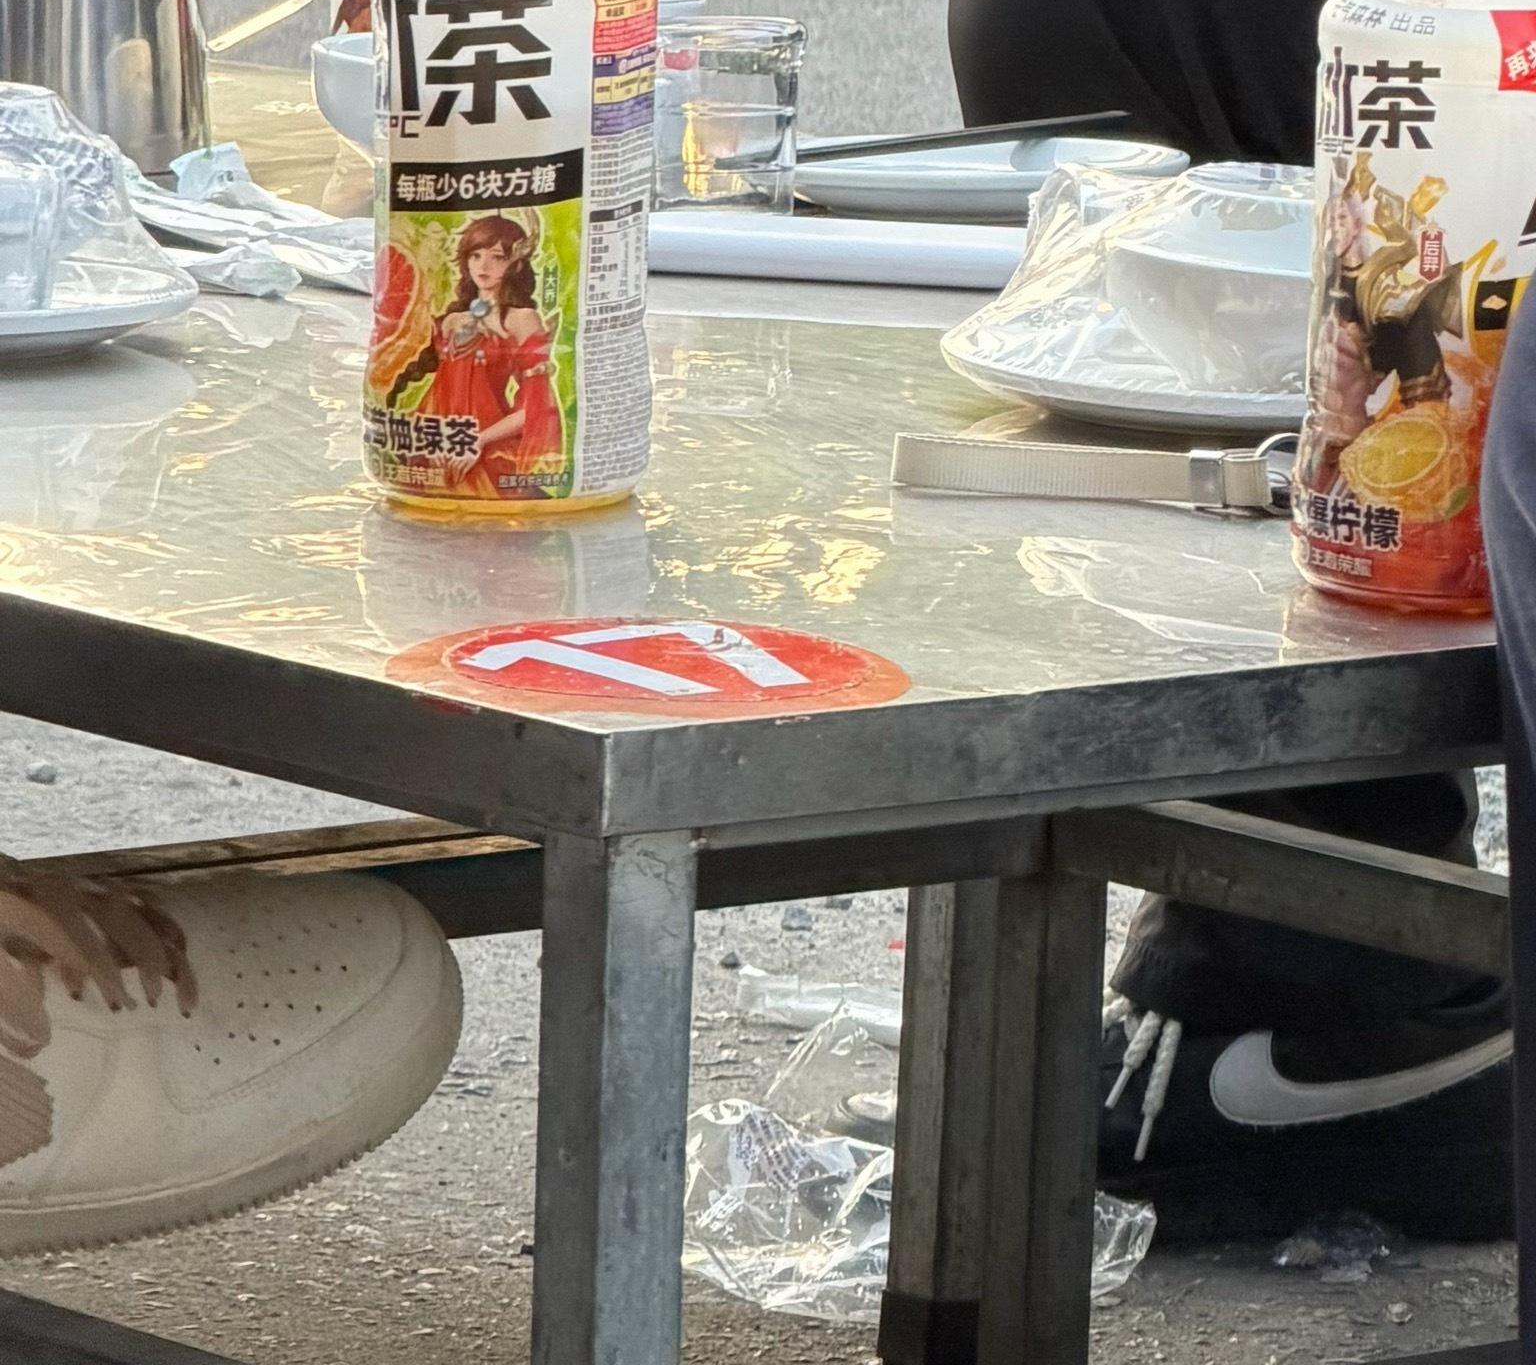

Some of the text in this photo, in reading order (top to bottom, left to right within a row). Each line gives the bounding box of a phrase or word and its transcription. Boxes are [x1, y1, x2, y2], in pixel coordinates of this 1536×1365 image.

[1389, 12, 1436, 35] 出品
[396, 165, 557, 201] 每瓶少6块方糖
[459, 623, 811, 695] 17
